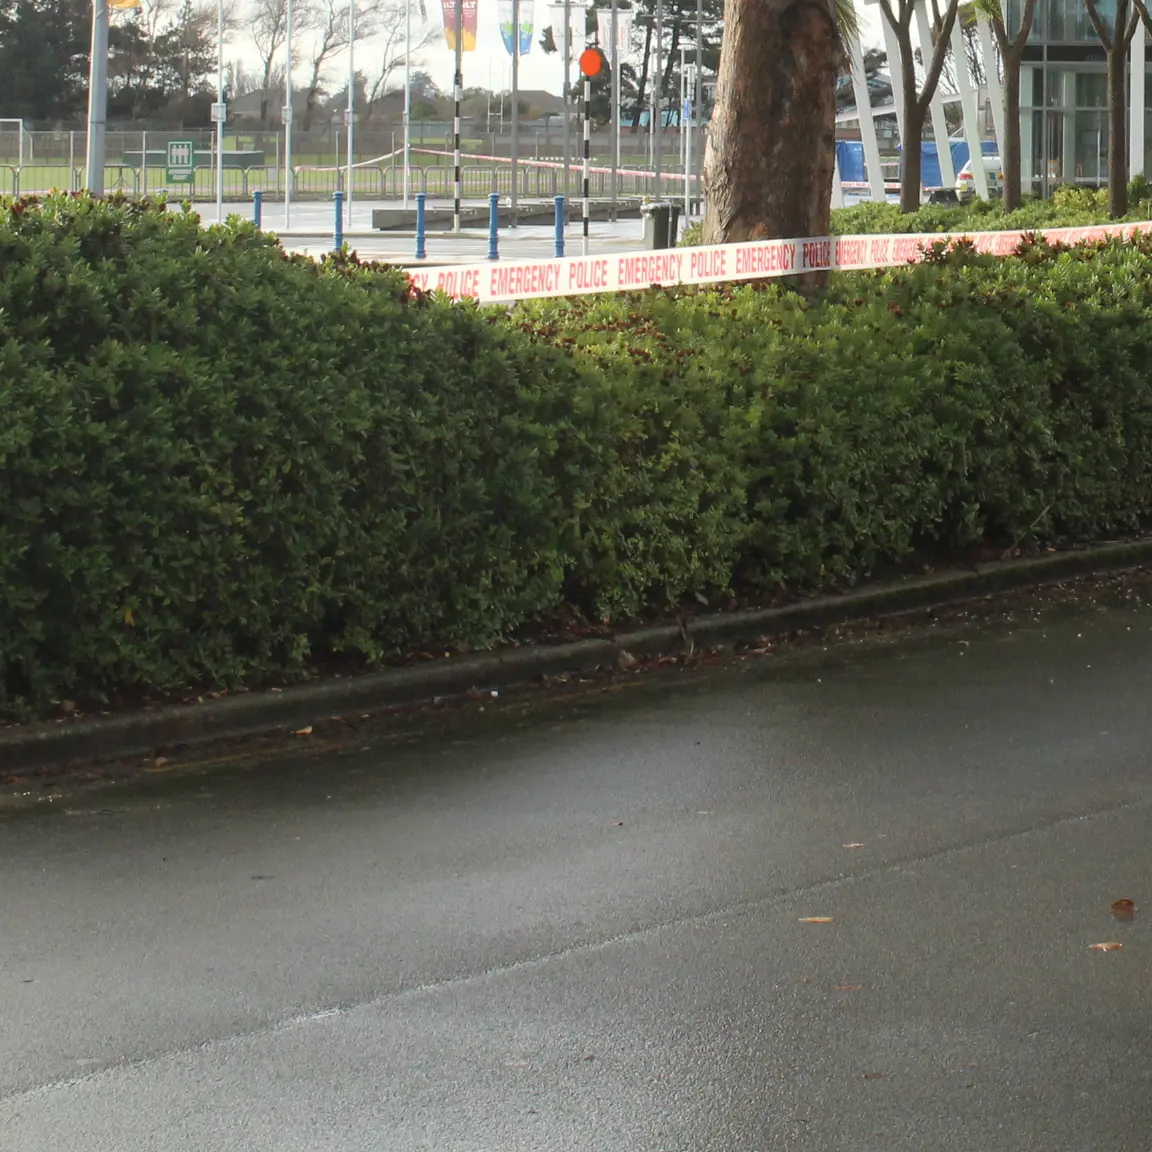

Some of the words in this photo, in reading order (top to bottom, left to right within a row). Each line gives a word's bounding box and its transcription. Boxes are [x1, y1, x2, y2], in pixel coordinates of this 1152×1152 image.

[438, 269, 479, 299] POLICE
[490, 263, 561, 296] EMERGENCY
[569, 259, 608, 290] POLICE
[618, 254, 683, 285] EMERGENCY
[690, 249, 726, 279] POLICE
[735, 243, 796, 274] EMERGENCY
[802, 240, 831, 268] POLICE
